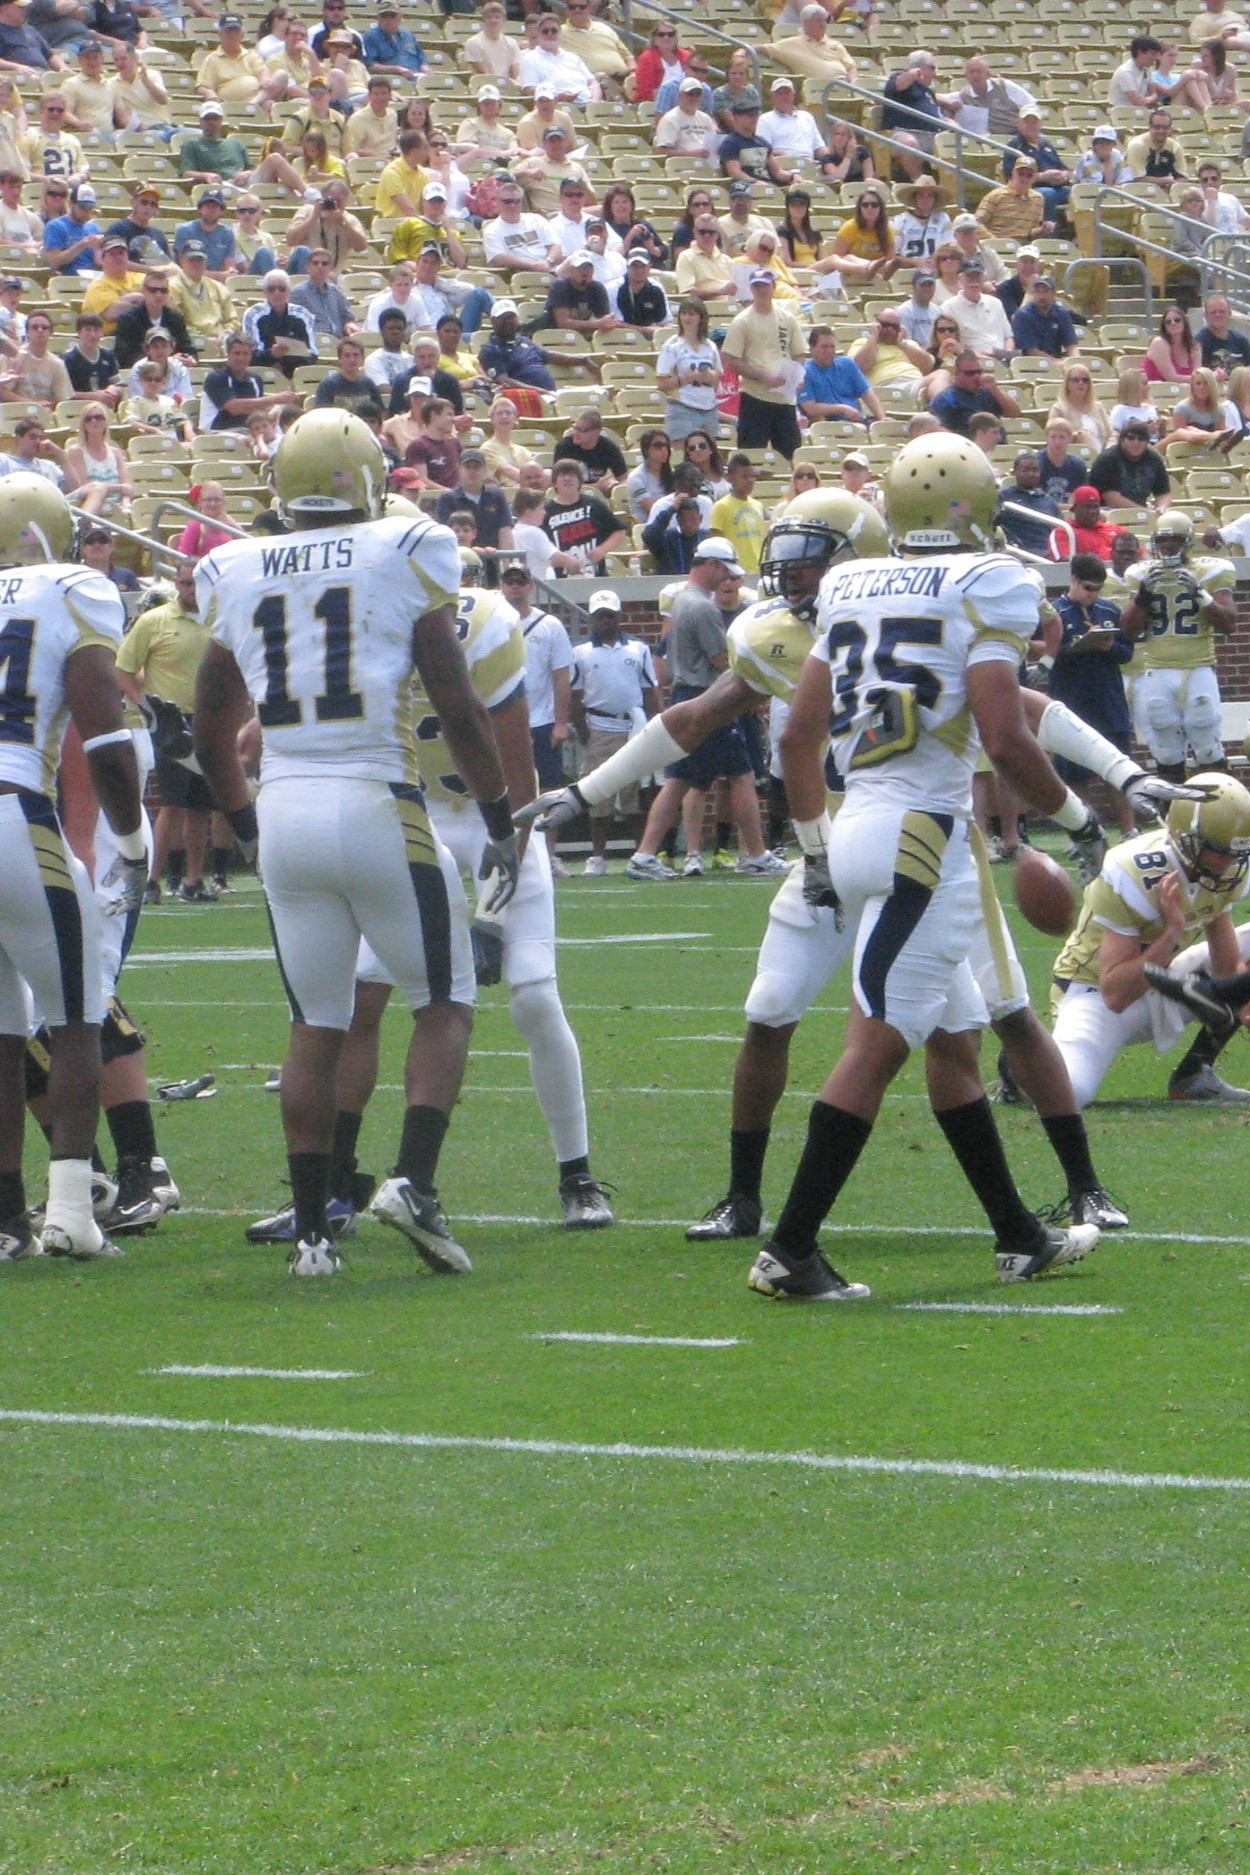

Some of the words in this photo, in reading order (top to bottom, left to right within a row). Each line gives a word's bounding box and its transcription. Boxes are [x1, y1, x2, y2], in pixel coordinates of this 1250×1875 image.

[43, 148, 75, 176] 21
[260, 537, 354, 578] WATTS
[829, 565, 950, 606] PETERSON
[253, 585, 365, 727] 11
[827, 616, 944, 738] 35
